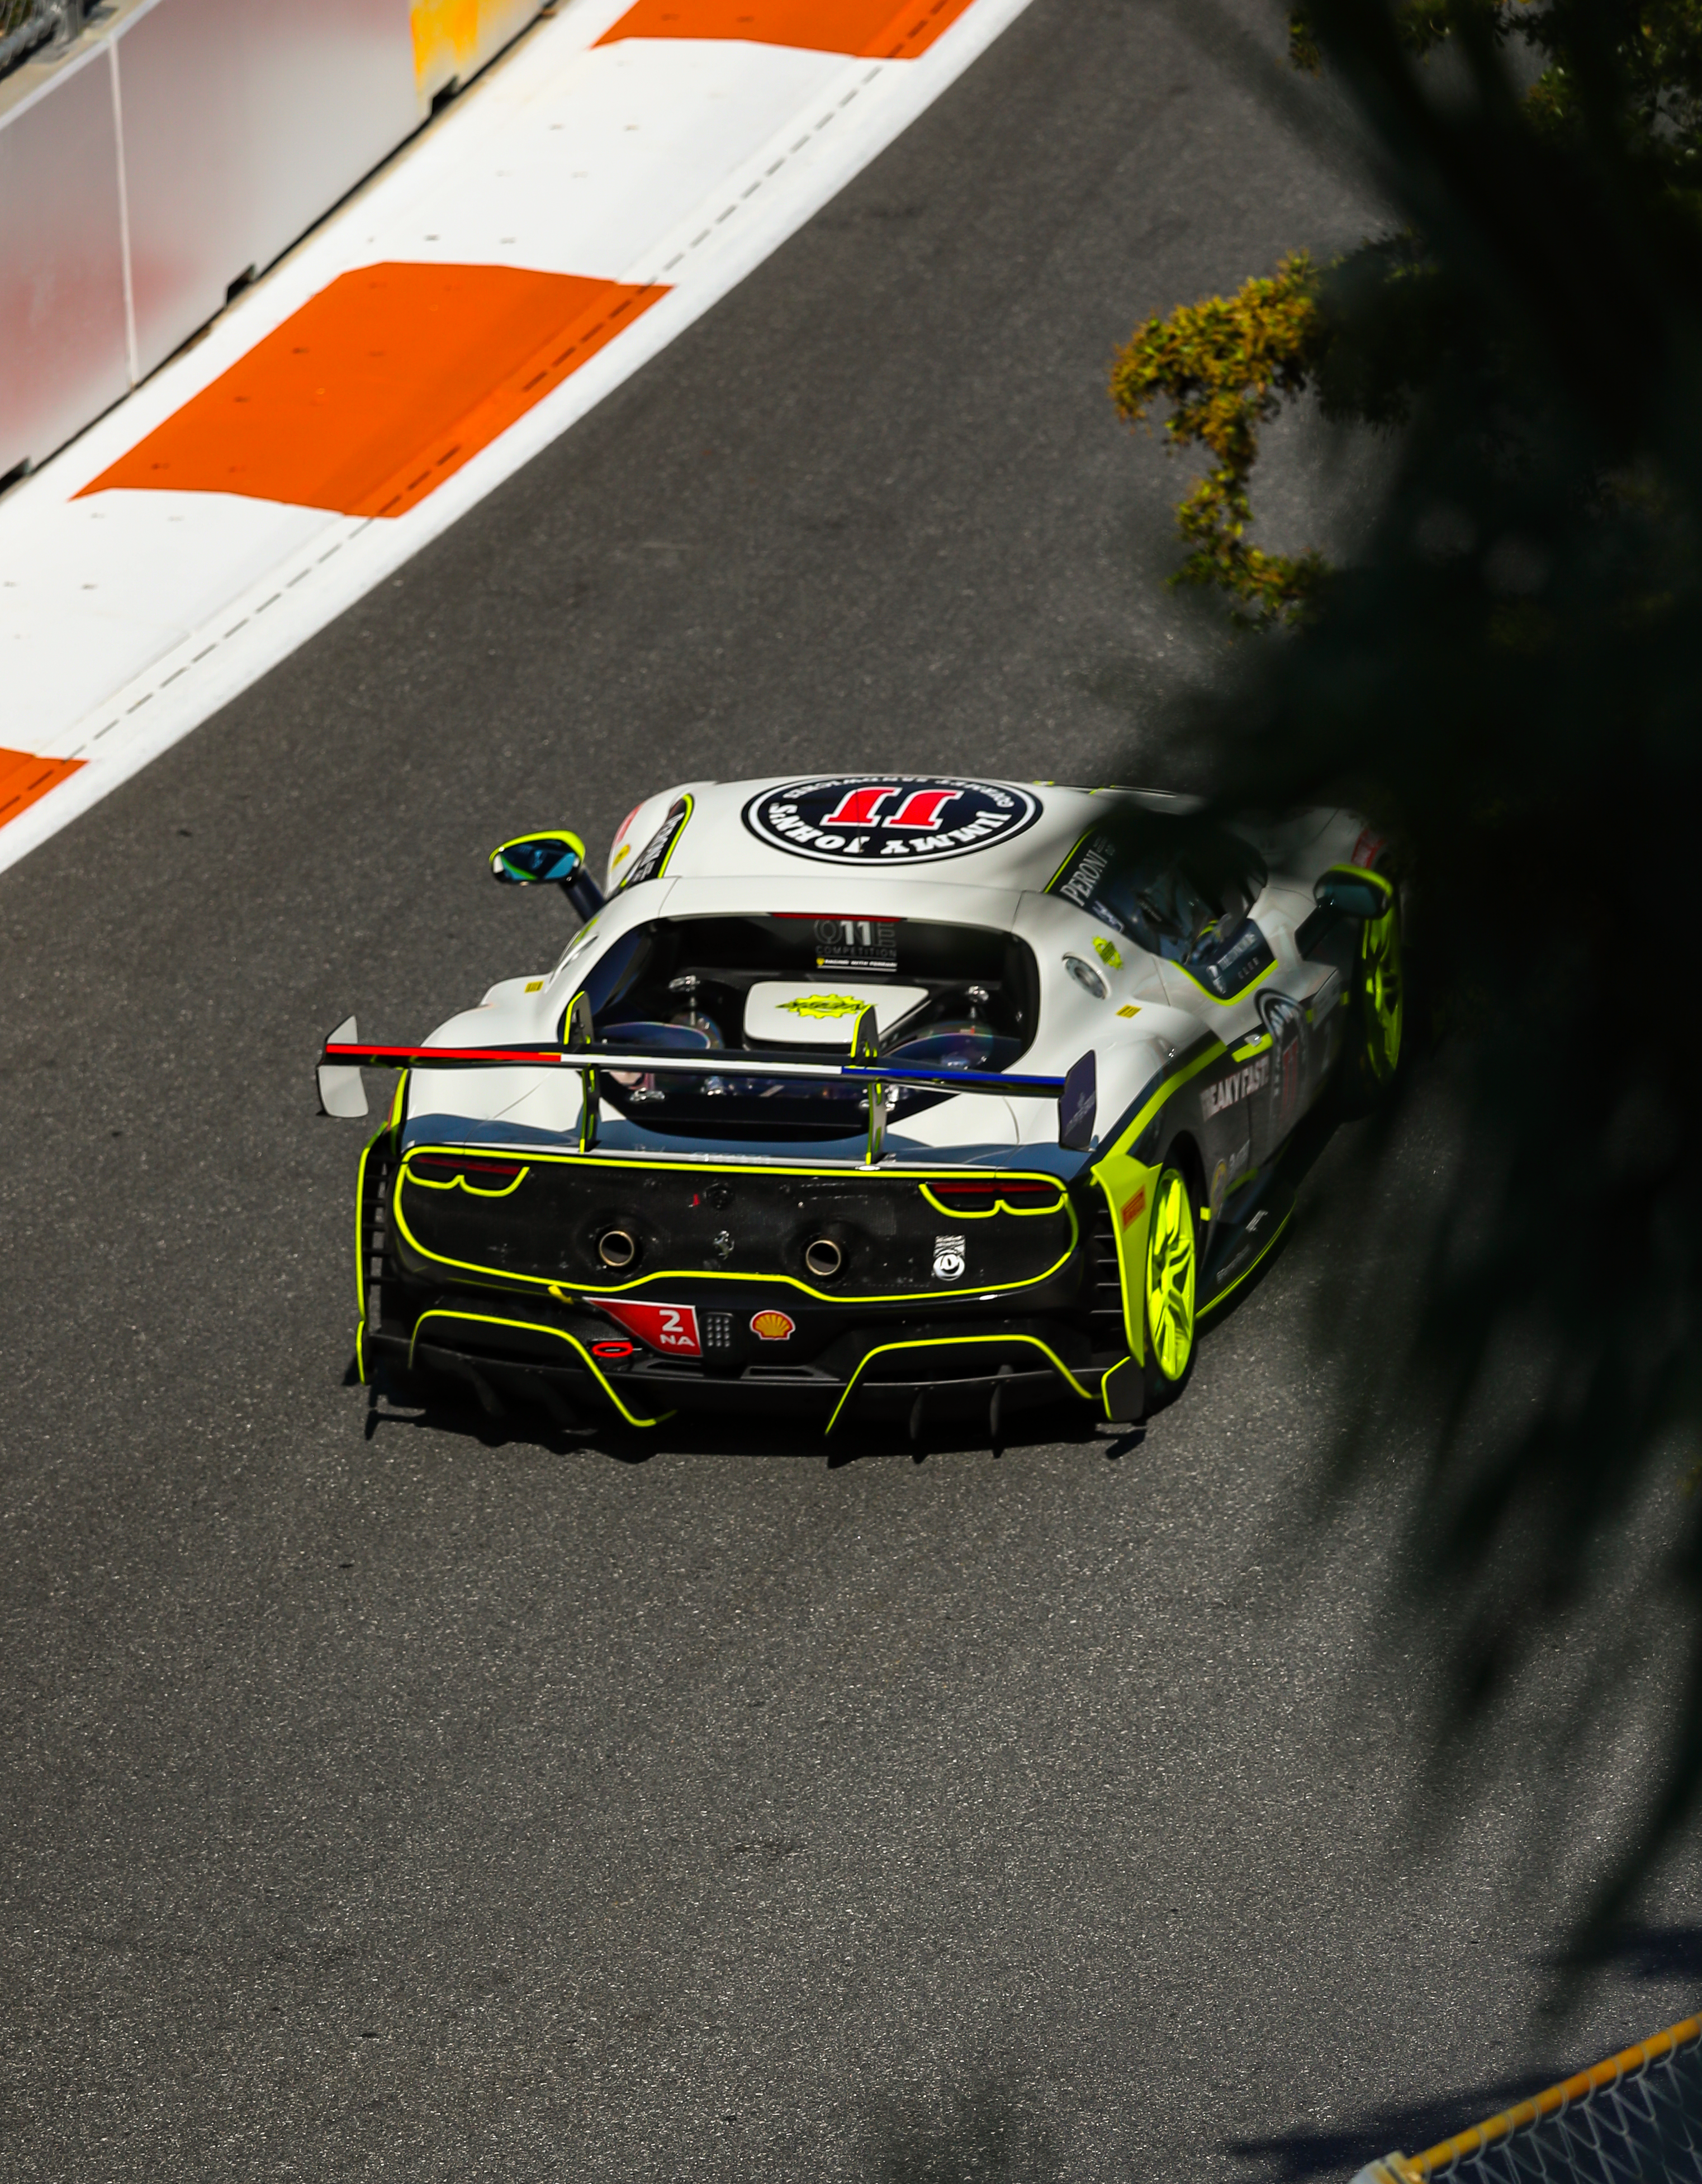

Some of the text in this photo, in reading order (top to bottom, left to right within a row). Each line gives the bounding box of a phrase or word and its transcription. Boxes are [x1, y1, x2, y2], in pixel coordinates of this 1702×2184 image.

[768, 803, 1013, 855] JIMMY JOHN'S
[1059, 849, 1108, 907] PERONI
[840, 920, 871, 946] 11
[816, 946, 897, 957] COMPETITION
[659, 1309, 684, 1333] 2
[659, 1333, 696, 1347] NA
